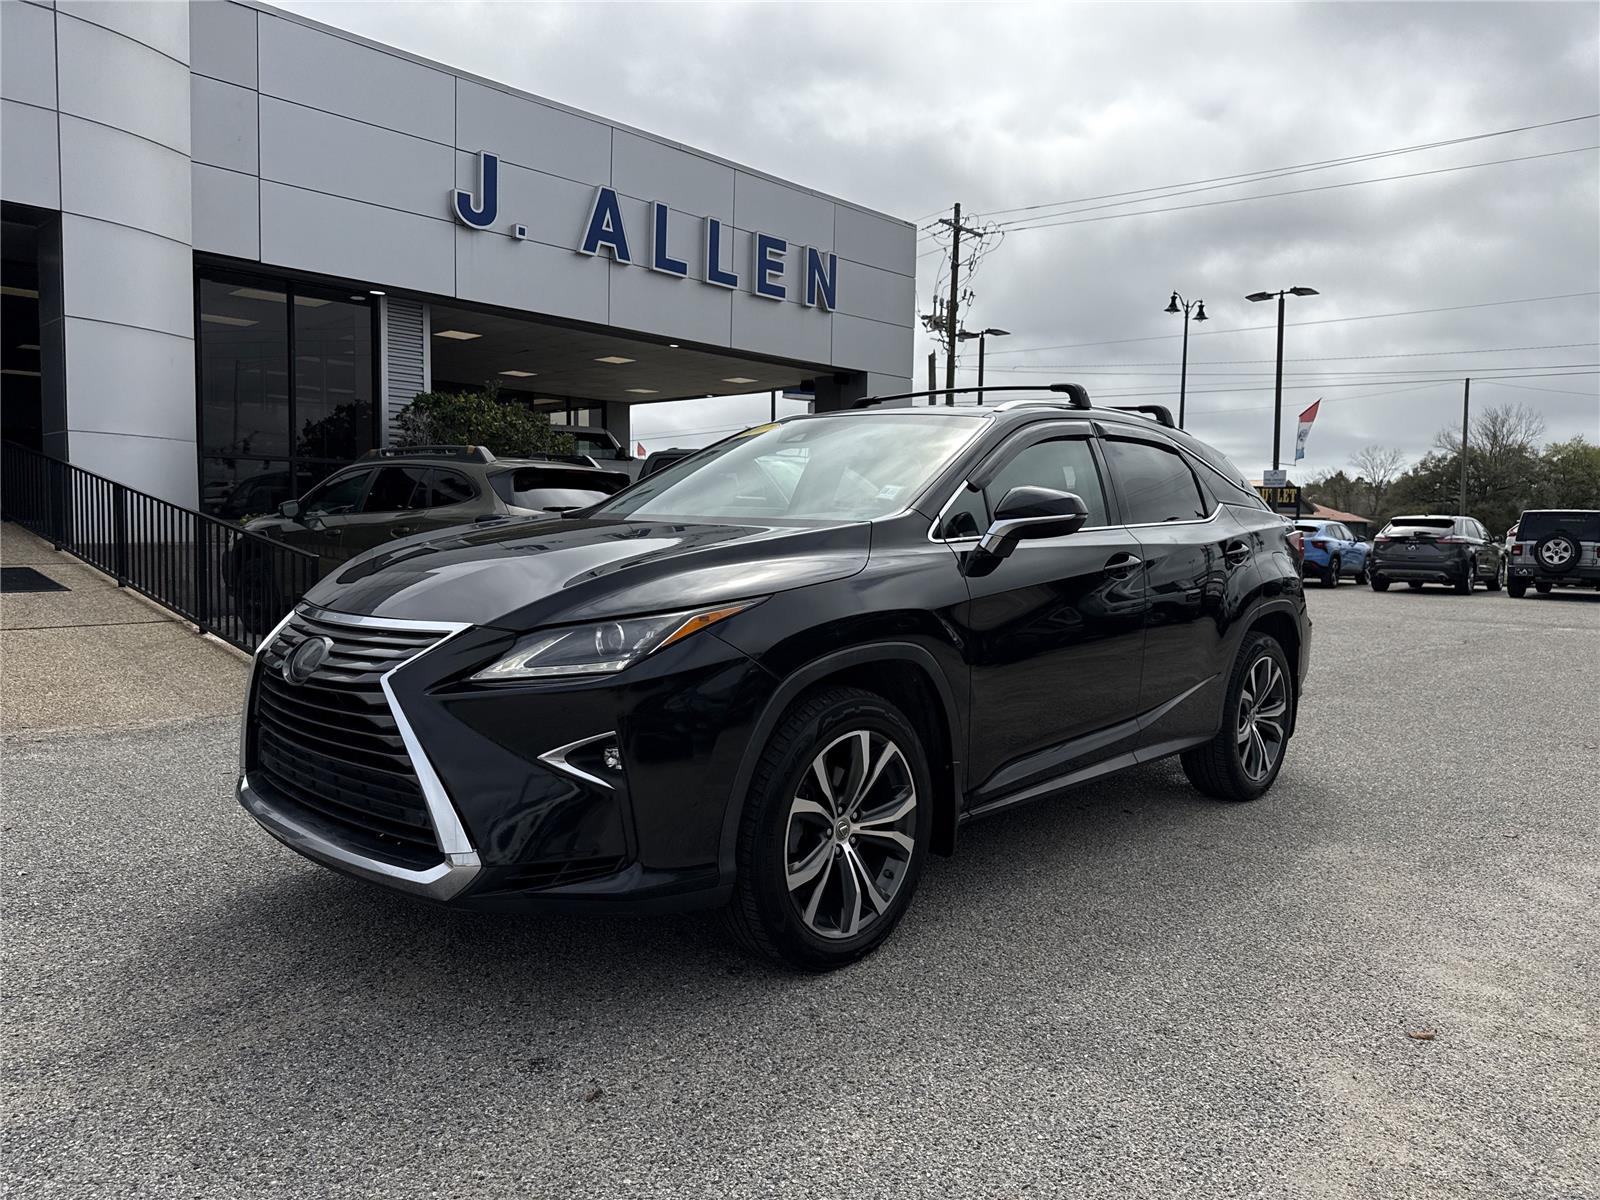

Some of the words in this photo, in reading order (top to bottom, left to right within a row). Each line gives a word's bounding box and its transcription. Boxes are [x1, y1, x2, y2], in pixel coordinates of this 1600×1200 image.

[451, 150, 528, 240] J.
[577, 185, 838, 312] ALLEN
[1257, 488, 1297, 503] ULET
